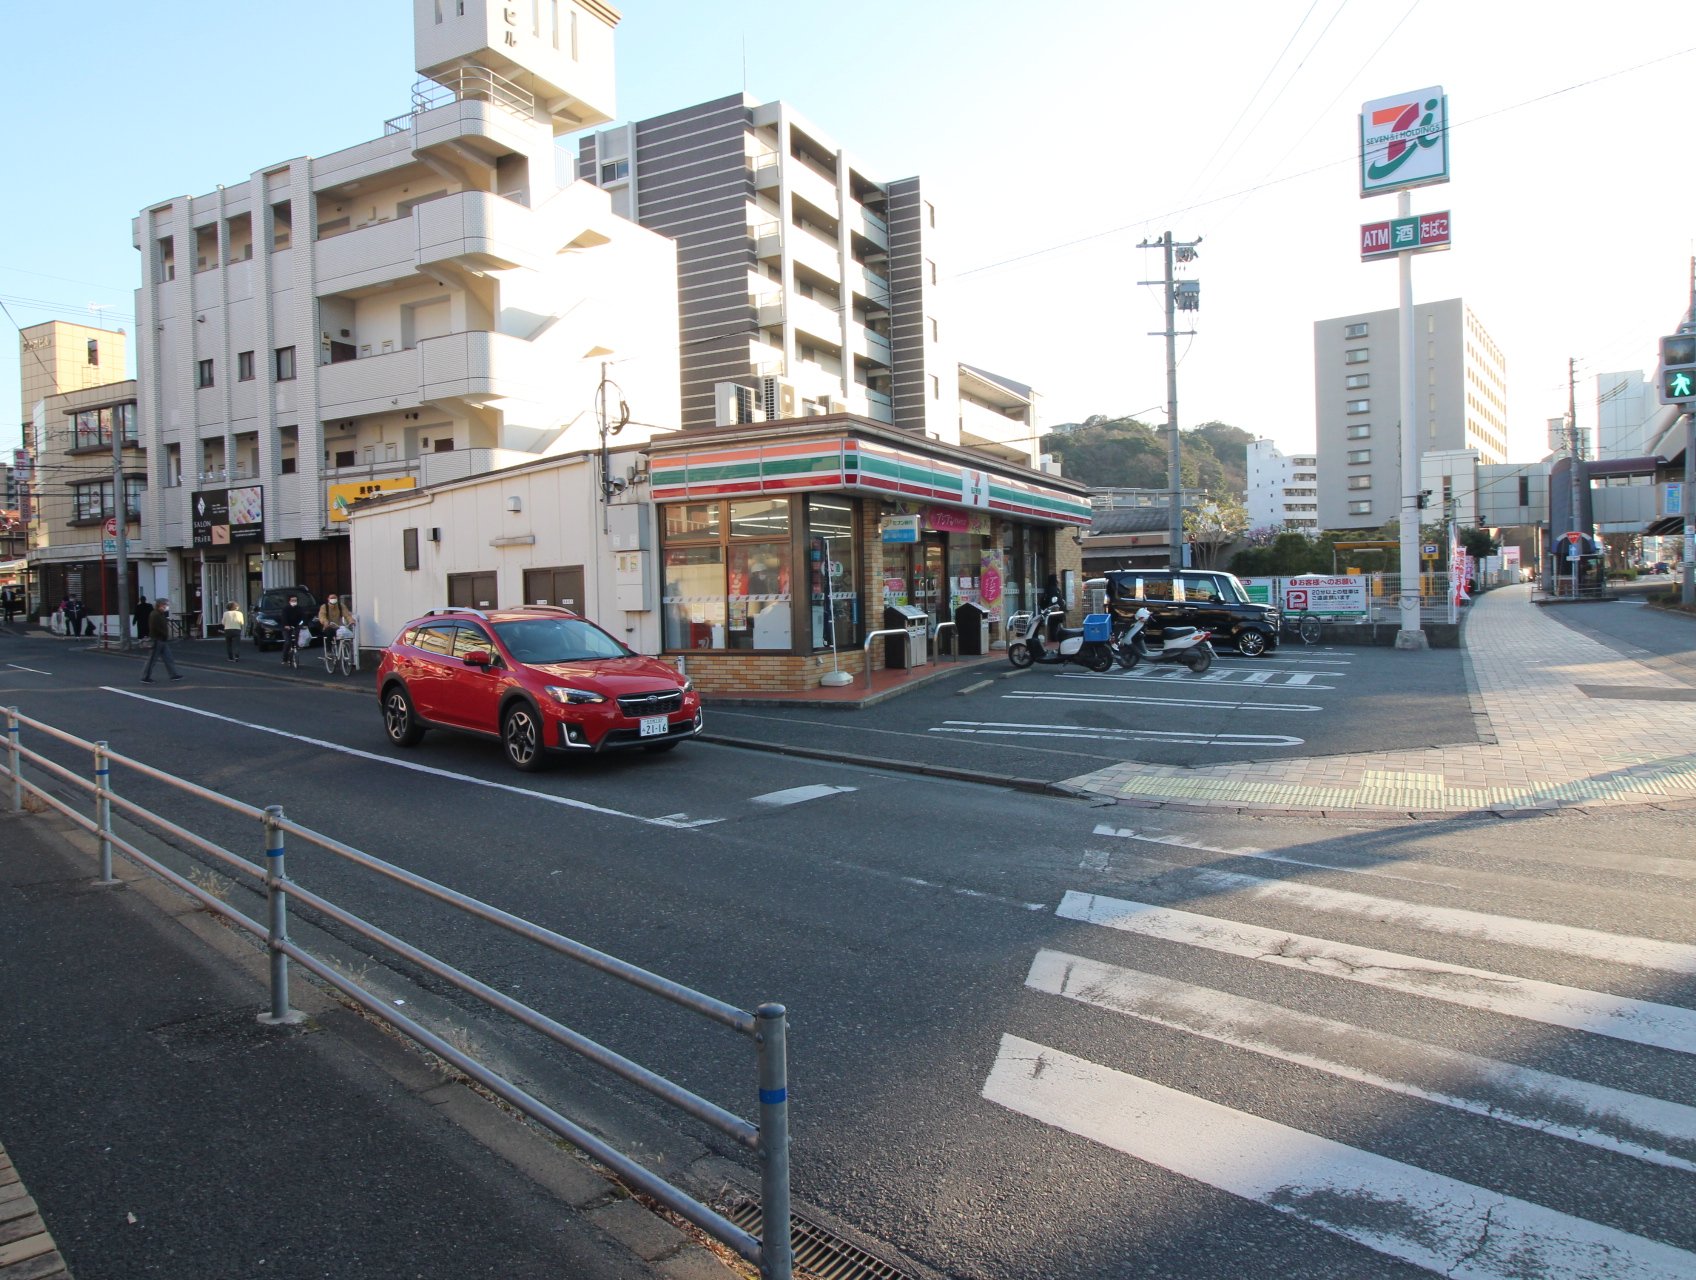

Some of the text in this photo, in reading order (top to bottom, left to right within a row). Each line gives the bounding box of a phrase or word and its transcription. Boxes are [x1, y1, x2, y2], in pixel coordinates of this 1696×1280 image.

[1400, 123, 1440, 141] HOLDINGS
[1396, 224, 1414, 243] 酒
[1420, 218, 1449, 239] たばこ
[1363, 228, 1389, 248] ATM
[1298, 578, 1357, 586] お客様へのお願い
[646, 724, 667, 734] 21-16
